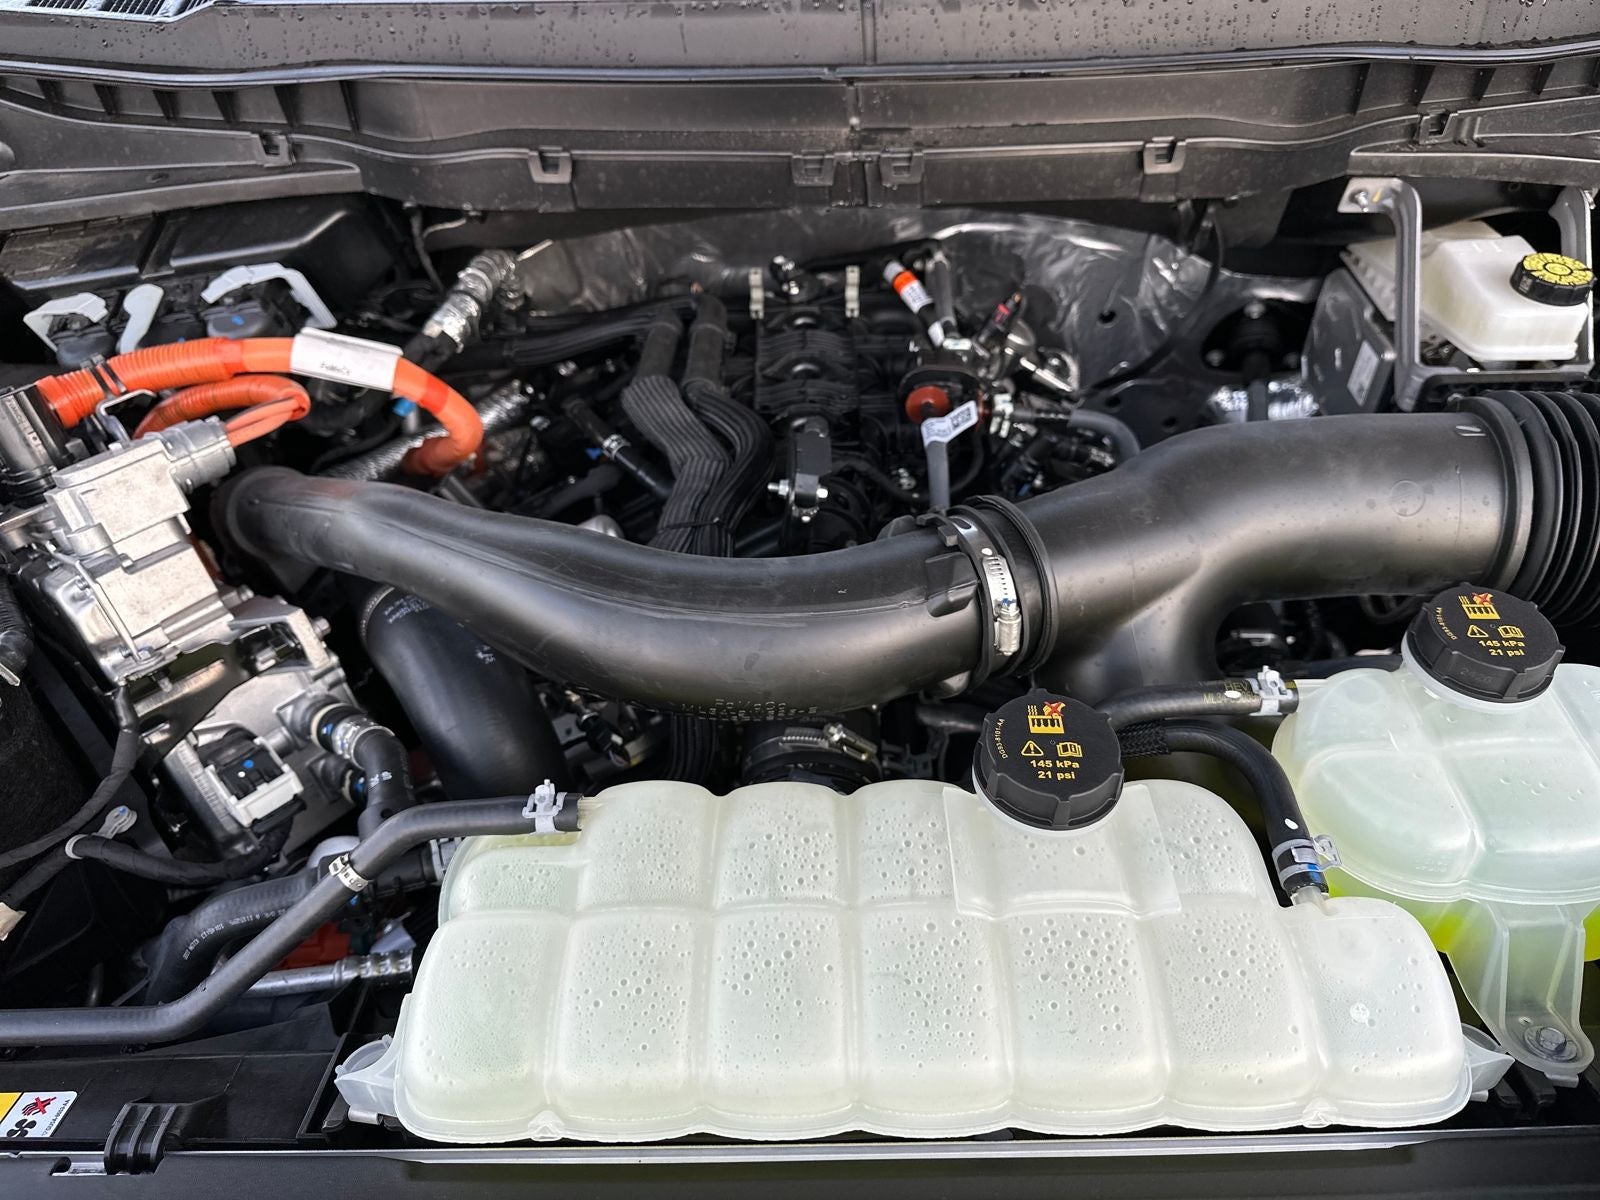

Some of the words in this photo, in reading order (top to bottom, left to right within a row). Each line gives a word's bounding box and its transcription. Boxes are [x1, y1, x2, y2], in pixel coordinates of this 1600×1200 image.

[1503, 640, 1525, 648] kPa
[1507, 649, 1525, 657] psi
[1224, 680, 1248, 691] HEV
[1030, 760, 1052, 768] 145
[1056, 760, 1080, 769] kPa
[1037, 771, 1052, 779] 21
[1057, 771, 1076, 781] psi
